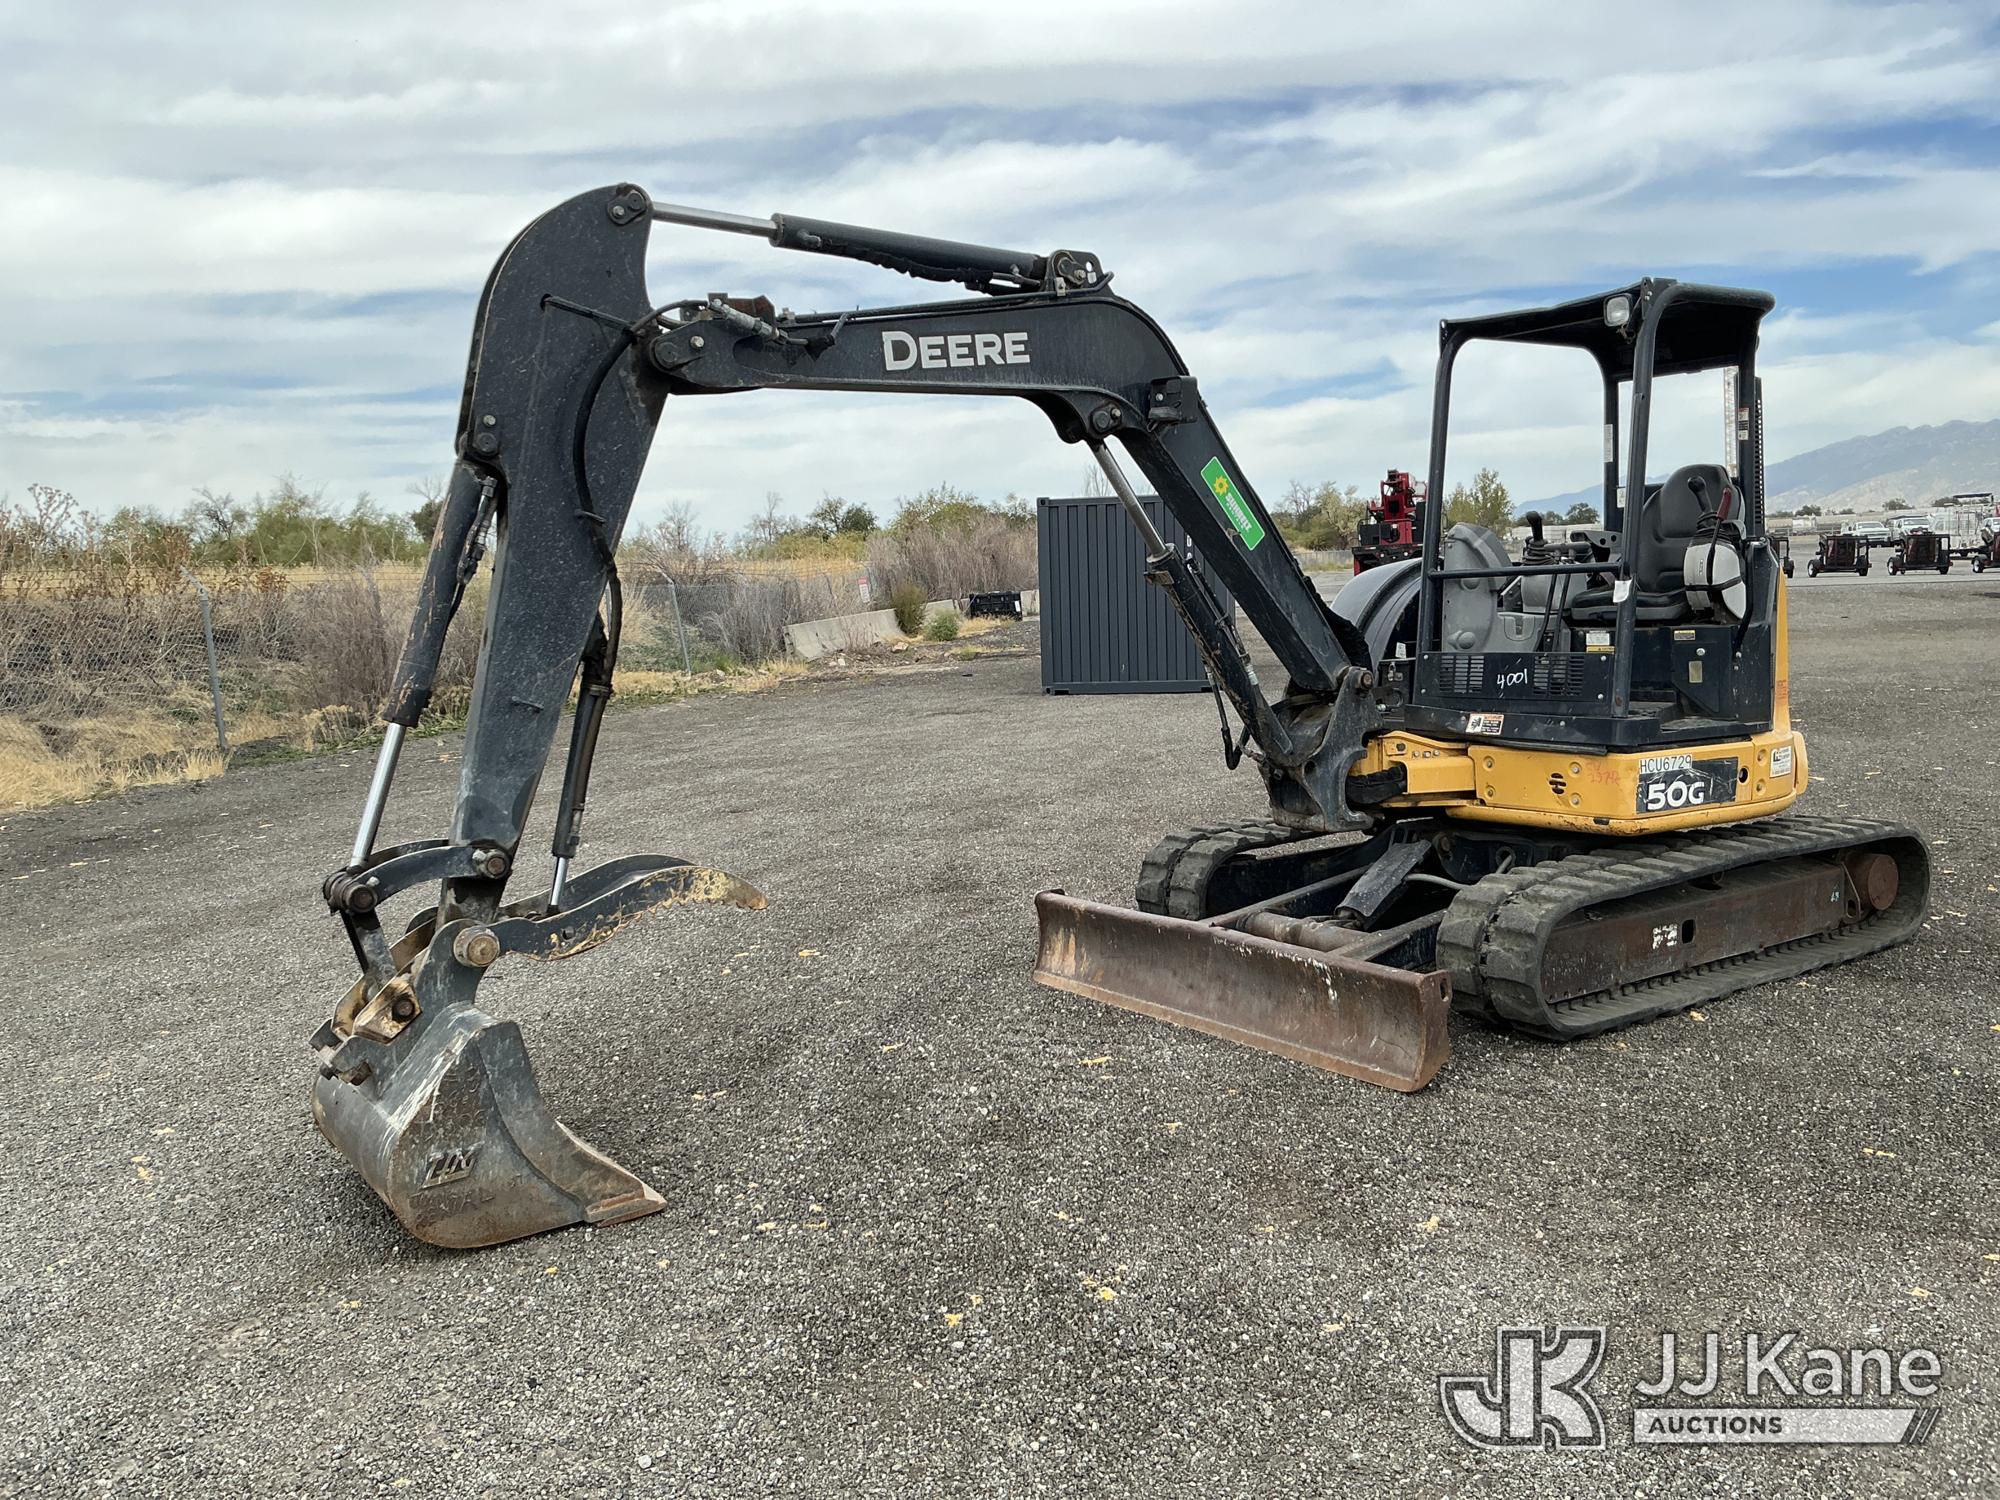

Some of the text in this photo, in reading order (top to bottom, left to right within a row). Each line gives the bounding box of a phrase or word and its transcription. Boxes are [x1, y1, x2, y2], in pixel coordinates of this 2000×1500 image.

[882, 330, 1031, 371] DEERE
[1496, 668, 1528, 689] 4001
[1640, 754, 1692, 773] HCU6729
[1647, 780, 1705, 811] 50G
